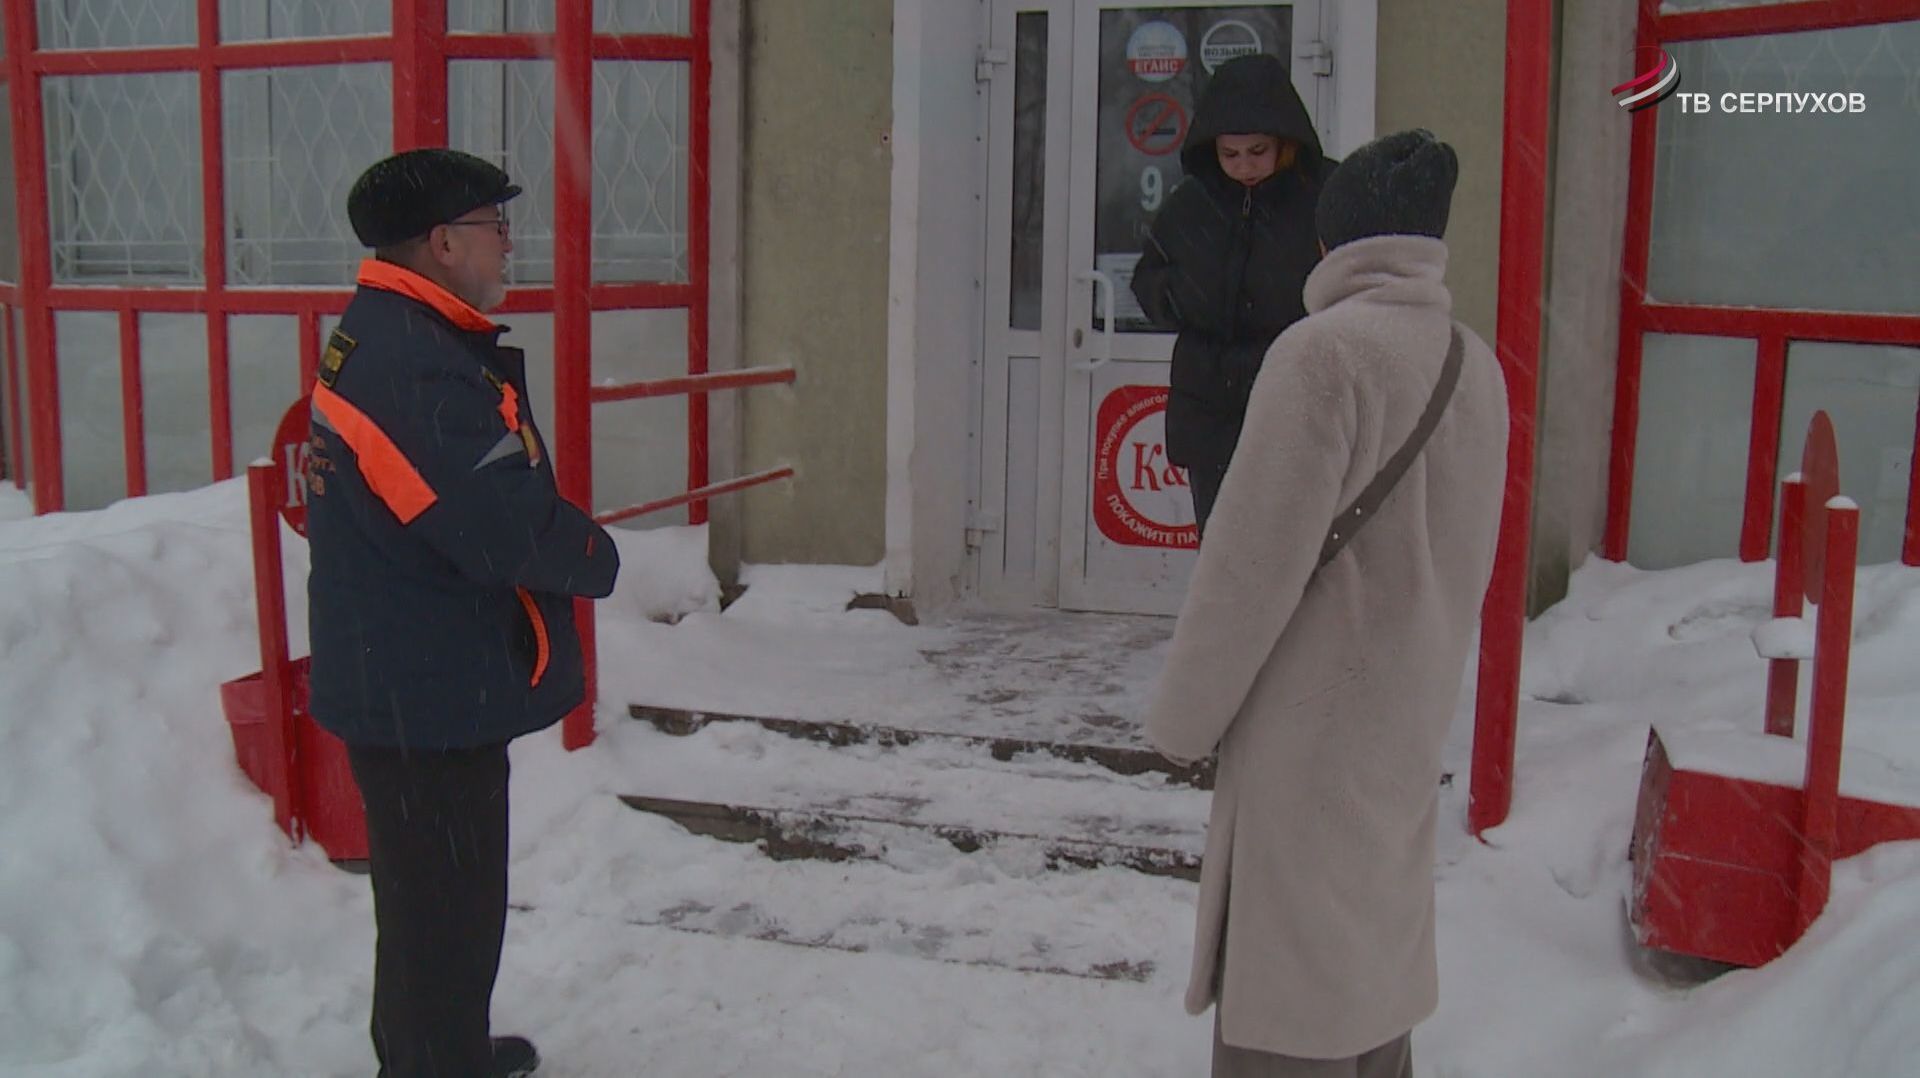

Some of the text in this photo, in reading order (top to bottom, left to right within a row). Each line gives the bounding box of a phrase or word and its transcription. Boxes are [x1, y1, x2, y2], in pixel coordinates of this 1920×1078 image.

[1134, 59, 1178, 73] ЕГАИС
[1141, 167, 1163, 211] 9
[1098, 458, 1108, 479] При
[1107, 494, 1174, 544] ПОКАЖИТЕ
